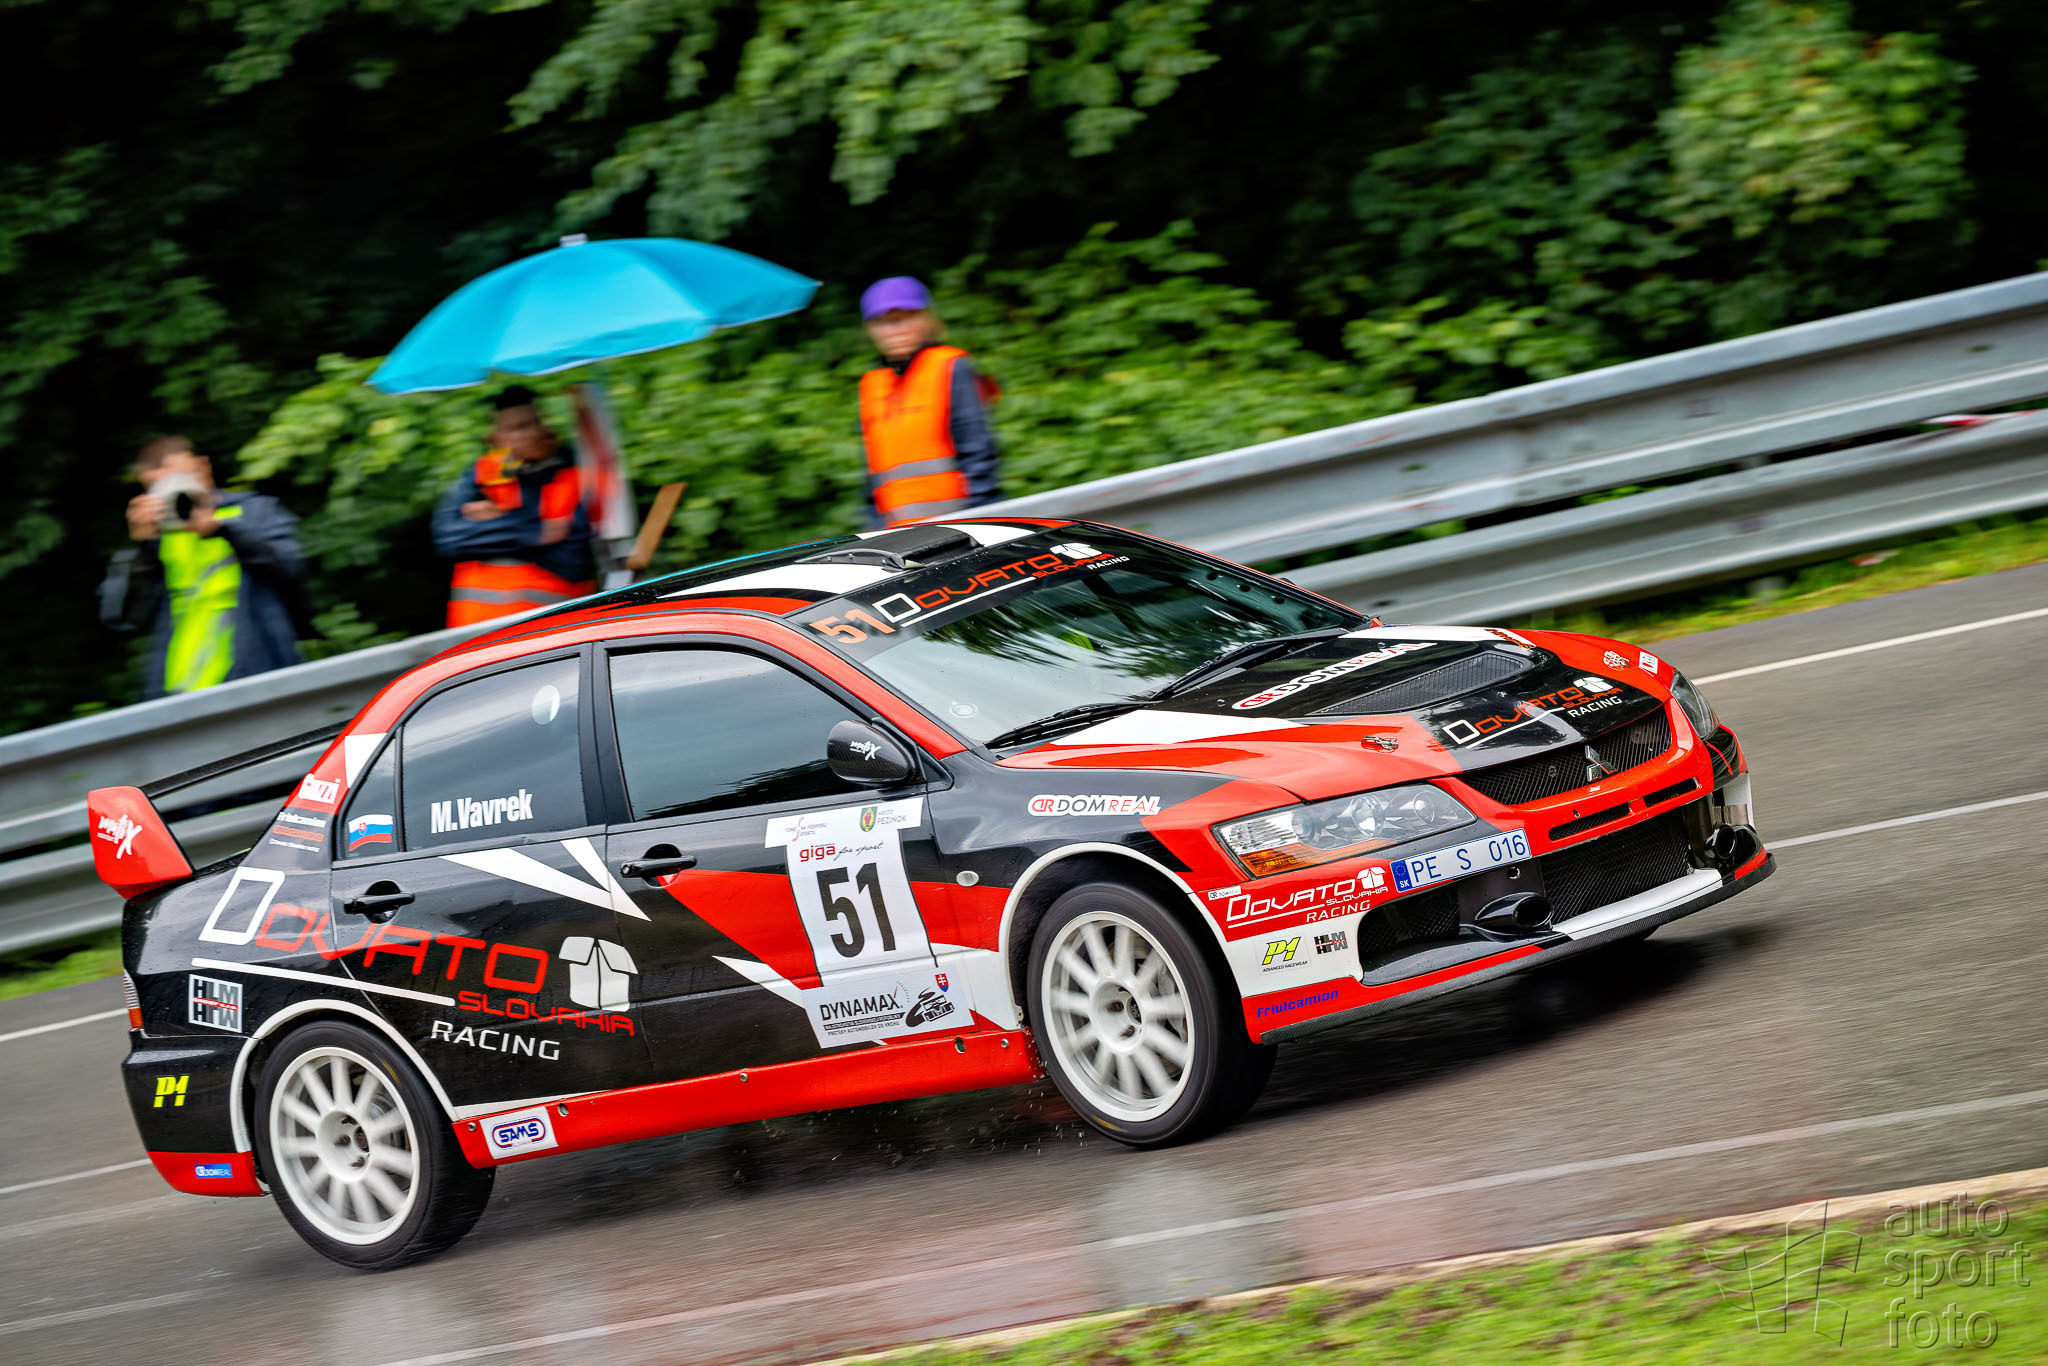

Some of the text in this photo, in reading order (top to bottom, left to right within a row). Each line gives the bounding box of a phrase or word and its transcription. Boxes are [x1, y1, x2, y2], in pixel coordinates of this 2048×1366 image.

[1088, 555, 1130, 570] RACING
[808, 607, 896, 645] 51
[1567, 695, 1623, 718] RACING
[431, 788, 534, 835] M.Vavrek
[1056, 798, 1157, 813] DOMREAL
[799, 845, 836, 863] giga
[1410, 833, 1527, 883] PE S 016
[1399, 878, 1410, 889] SK
[815, 862, 897, 958] 51
[1306, 899, 1371, 924] RACING
[1261, 936, 1302, 966] P1
[819, 993, 901, 1021] DYNAMAX
[431, 1020, 560, 1061] RACING
[153, 1075, 190, 1108] P1
[498, 1122, 539, 1143] SAMS
